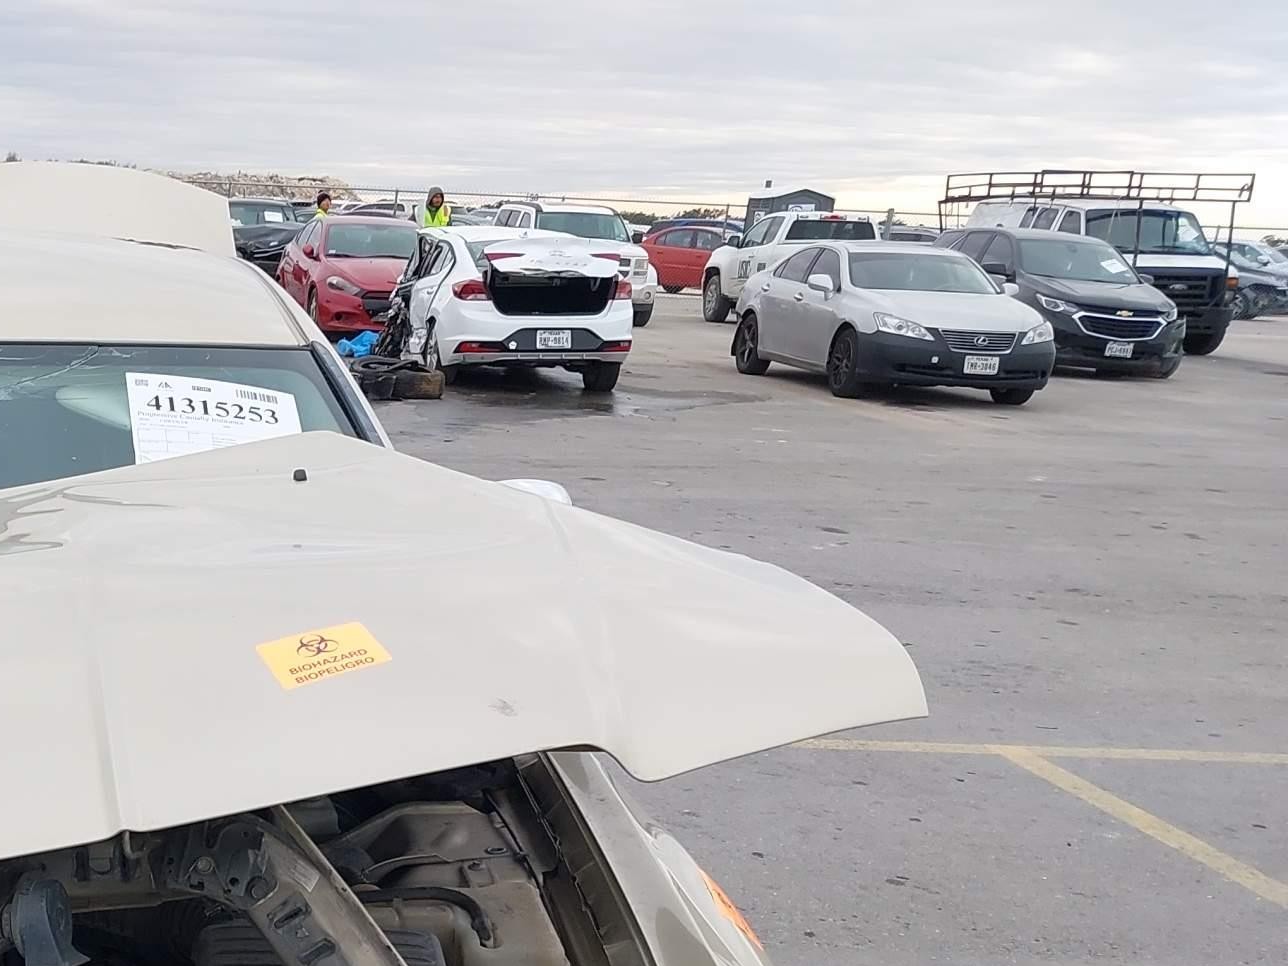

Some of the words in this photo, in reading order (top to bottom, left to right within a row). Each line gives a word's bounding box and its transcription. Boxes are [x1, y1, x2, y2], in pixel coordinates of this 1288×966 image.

[146, 394, 279, 425] 41315253
[289, 648, 368, 675] BIOHAZARD
[295, 656, 375, 684] BIOPELIGRO
